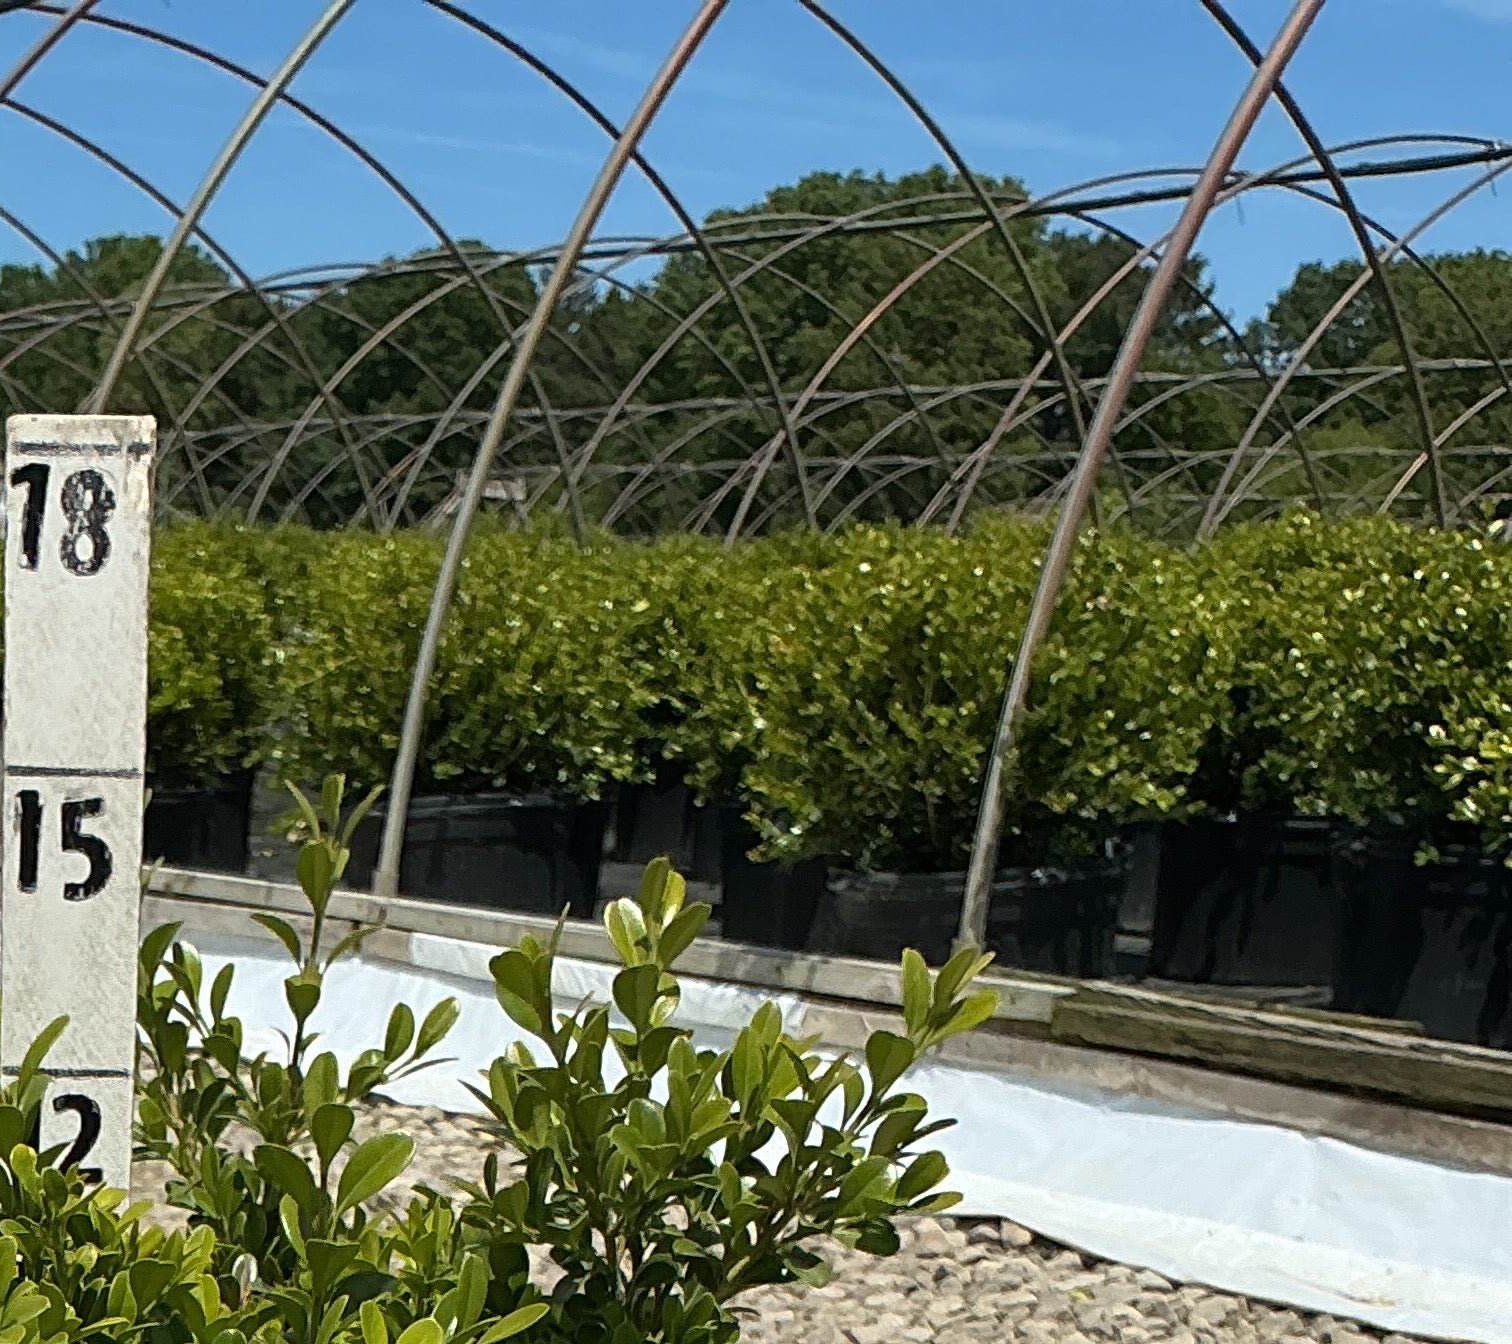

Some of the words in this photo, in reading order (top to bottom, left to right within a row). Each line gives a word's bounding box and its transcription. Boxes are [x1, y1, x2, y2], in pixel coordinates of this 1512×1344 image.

[10, 463, 116, 577] 18
[12, 789, 113, 903] 15
[52, 1093, 104, 1184] 2
